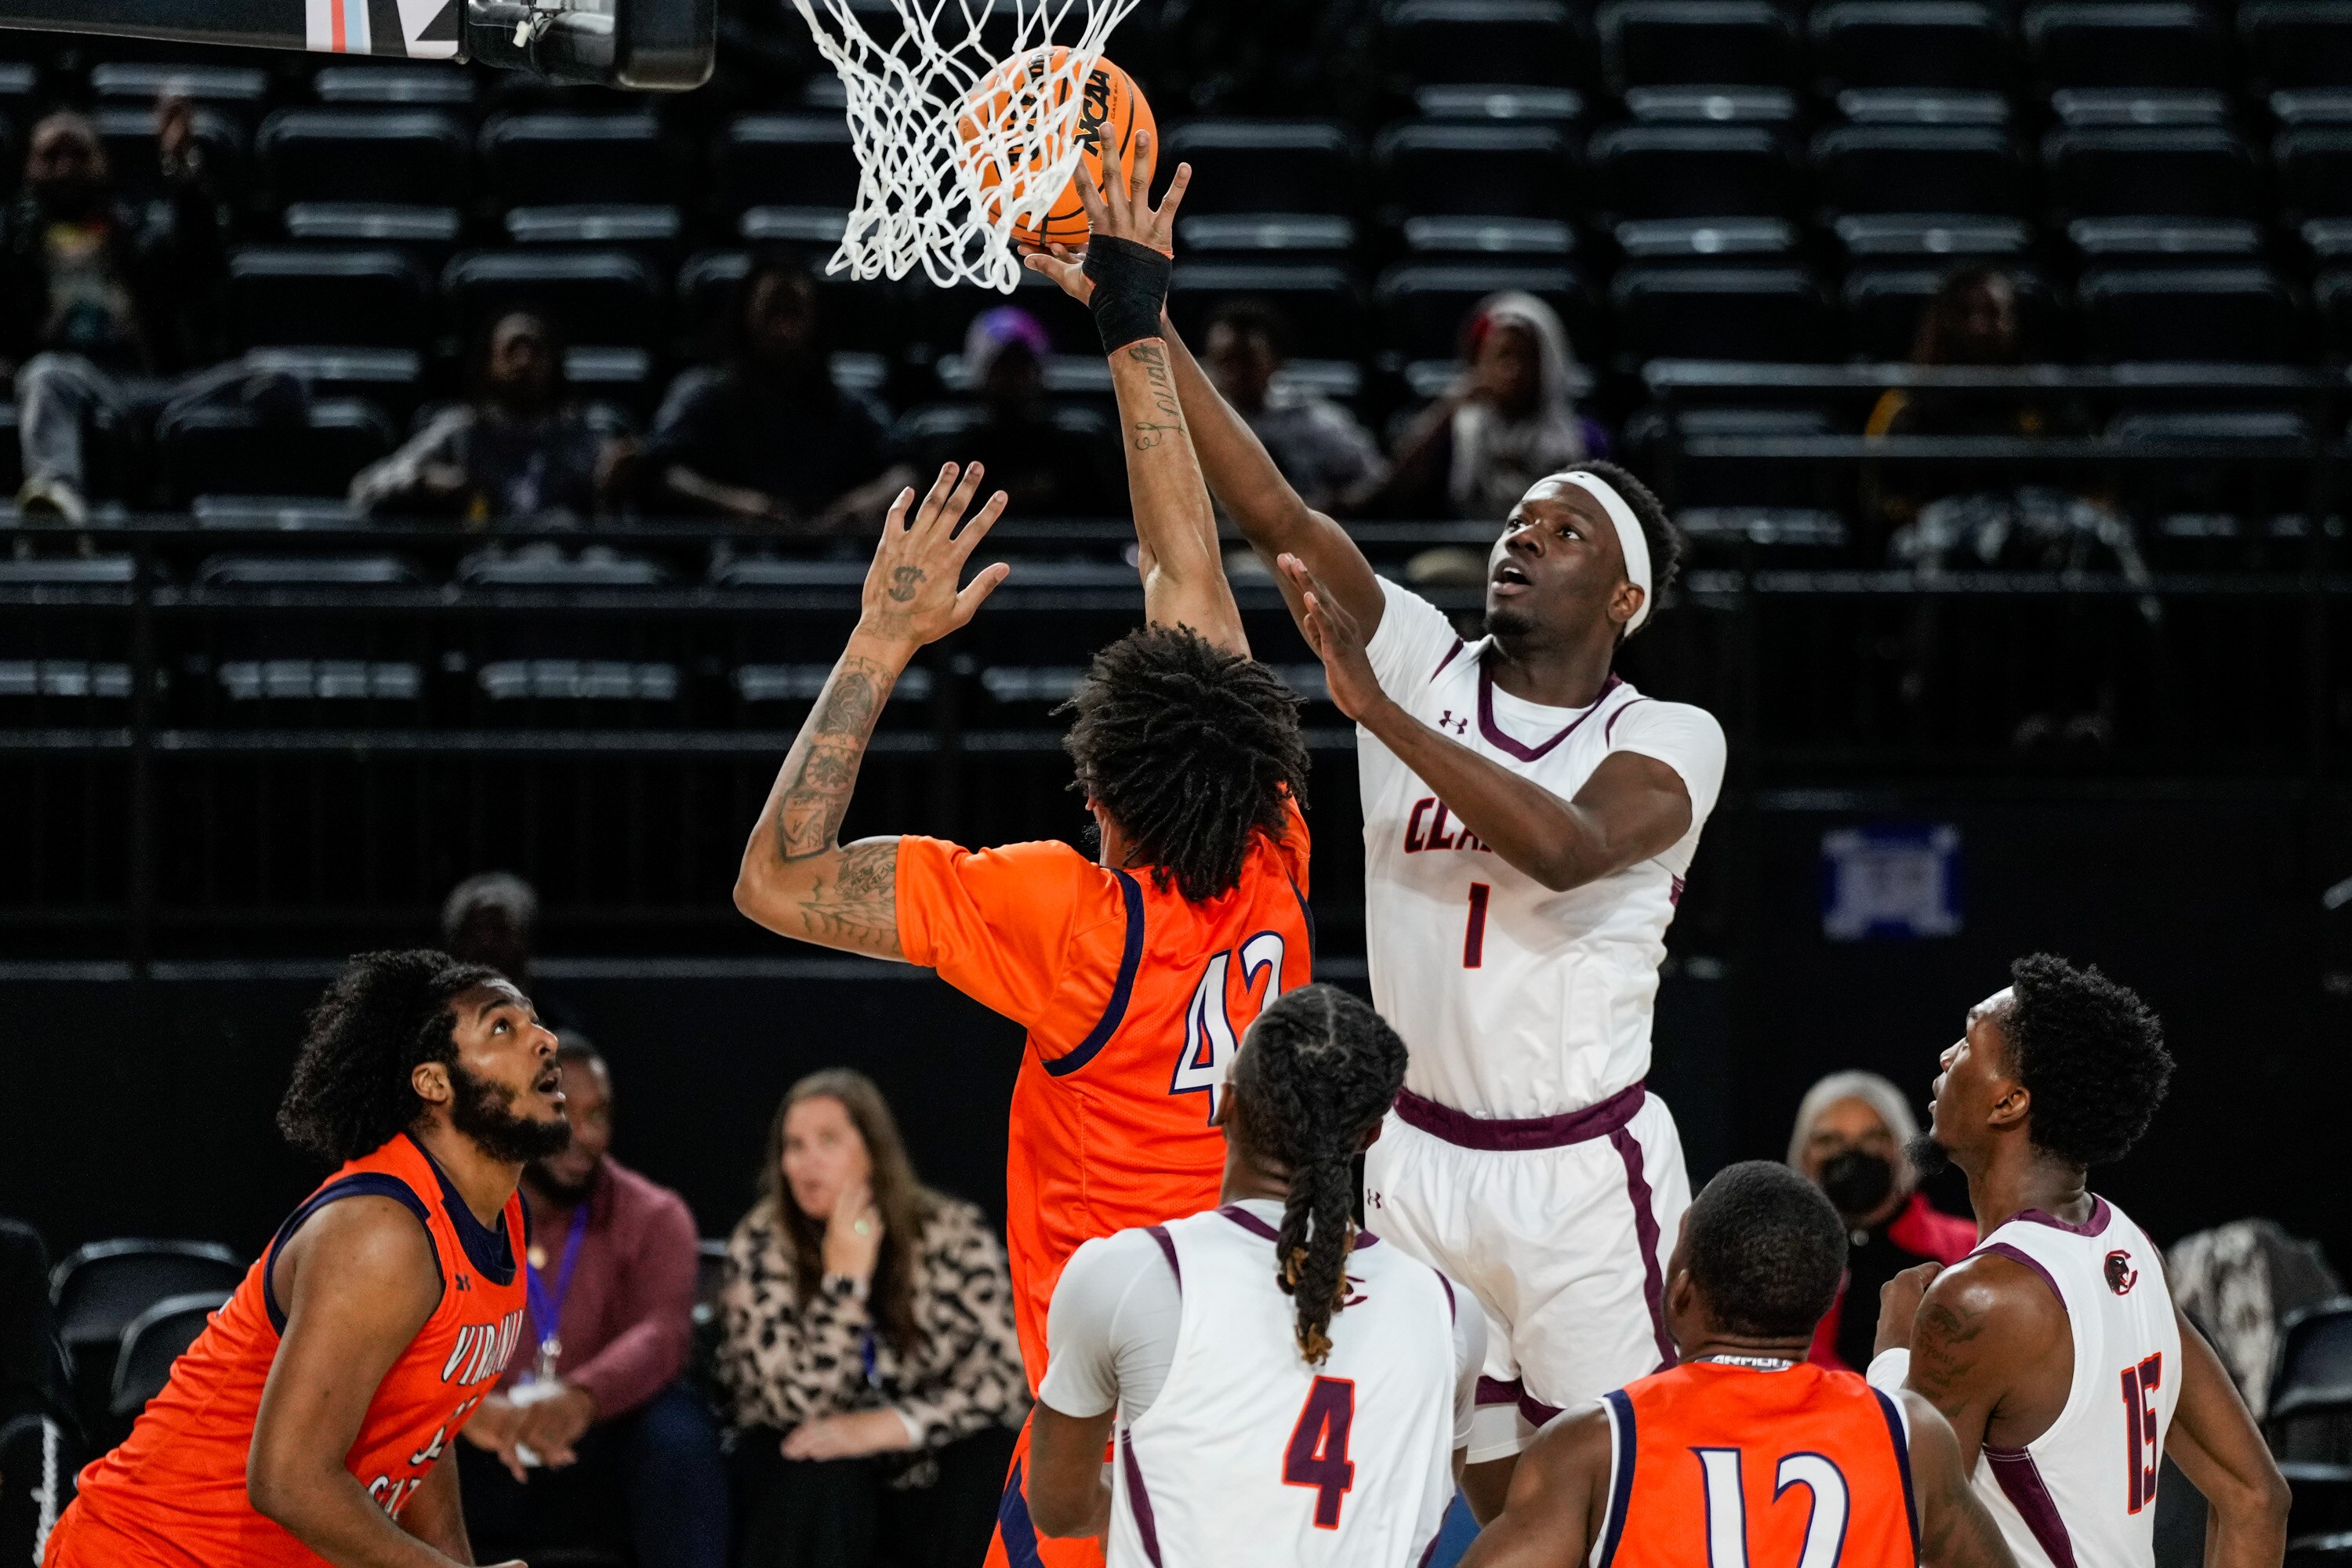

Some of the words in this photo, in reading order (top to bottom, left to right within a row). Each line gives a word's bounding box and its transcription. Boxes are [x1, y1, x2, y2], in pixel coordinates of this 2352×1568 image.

[1073, 69, 1111, 157] NCAA
[1462, 881, 1490, 969] 1
[1281, 1374, 1356, 1530] 4
[2120, 1351, 2162, 1515] 15
[1686, 1446, 1850, 1568] 12
